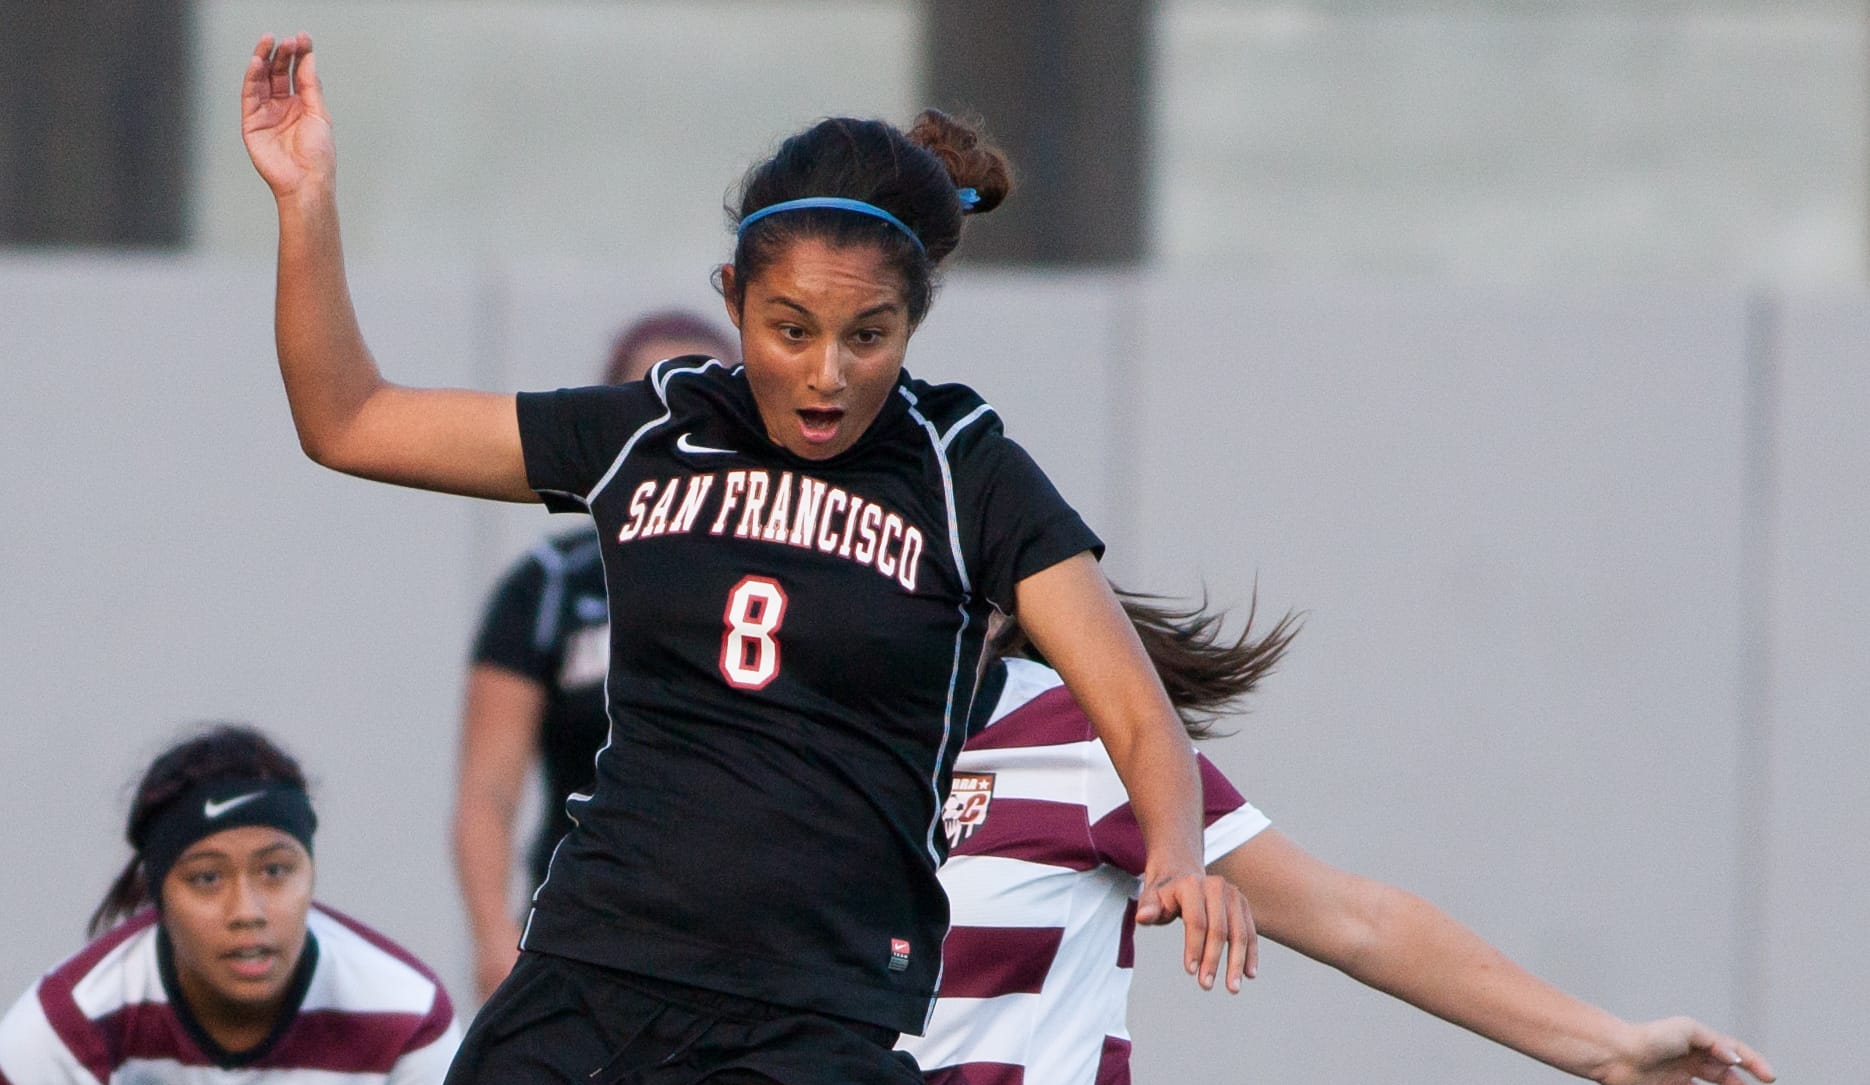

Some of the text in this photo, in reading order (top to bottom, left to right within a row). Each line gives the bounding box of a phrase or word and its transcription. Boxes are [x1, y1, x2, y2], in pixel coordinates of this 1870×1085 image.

[618, 470, 924, 592] SAN FRANCISCO
[719, 574, 789, 690] 8
